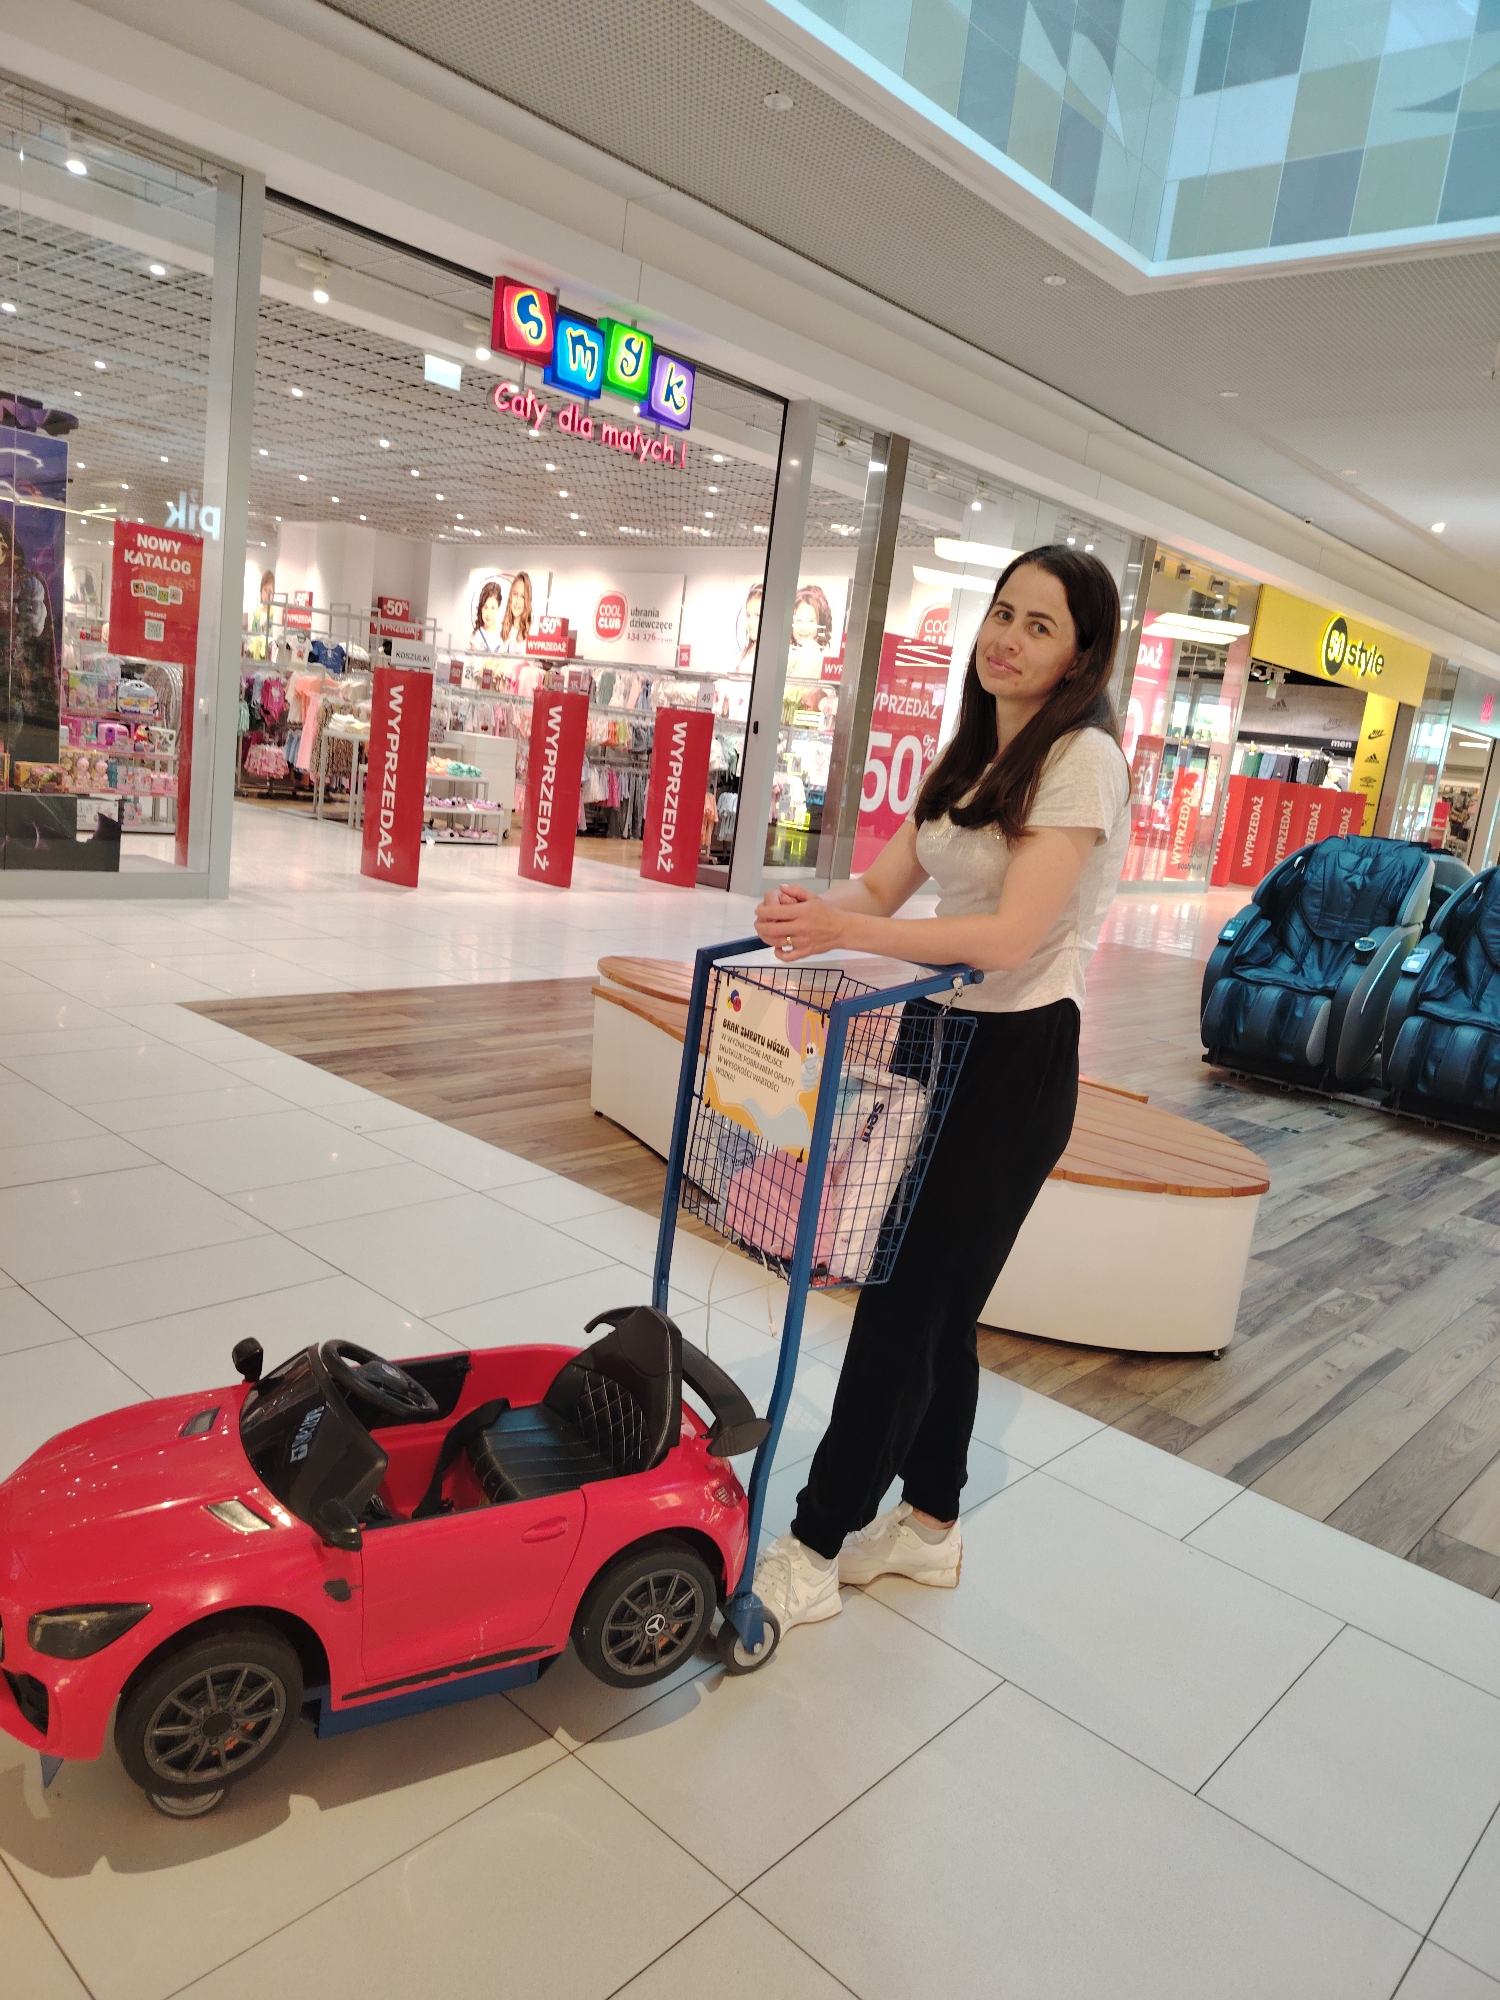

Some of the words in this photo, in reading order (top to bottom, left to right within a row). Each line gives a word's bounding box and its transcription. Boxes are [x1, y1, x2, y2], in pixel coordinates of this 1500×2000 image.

[558, 403, 593, 439] dla
[136, 533, 182, 555] NOWY
[124, 549, 192, 575] KATALOG
[598, 617, 621, 629] CLUB
[599, 604, 622, 617] COOL
[629, 618, 673, 633] dziewczęce
[630, 606, 660, 618] ubrania
[395, 651, 431, 664] KOSZULKI
[527, 640, 567, 653] WYPRZEDAŻ
[1330, 739, 1352, 749] men
[376, 684, 406, 869] WYPRZEDAŻ
[533, 705, 563, 872] WYPRZEDAŻ
[656, 721, 688, 873] WYPRZEDAŻ
[1170, 787, 1194, 866] WYPRZEDAŻ
[1241, 795, 1264, 868] WYPRZEDAŻ
[722, 1018, 740, 1035] BRAK
[740, 1026, 766, 1047] ZWROTU
[766, 1039, 790, 1059] WÓZKA
[727, 1035, 761, 1059] WYZNACZONE
[762, 1052, 784, 1069] MIEJSCE
[715, 1065, 736, 1083] WÓZKA!
[719, 1043, 743, 1062] SKUTKUJE
[743, 1055, 774, 1078] POBRANIEM
[773, 1070, 796, 1087] OPŁATY
[723, 1058, 753, 1079] WYSOKOŚCI
[752, 1073, 780, 1093] WARTOŚCI
